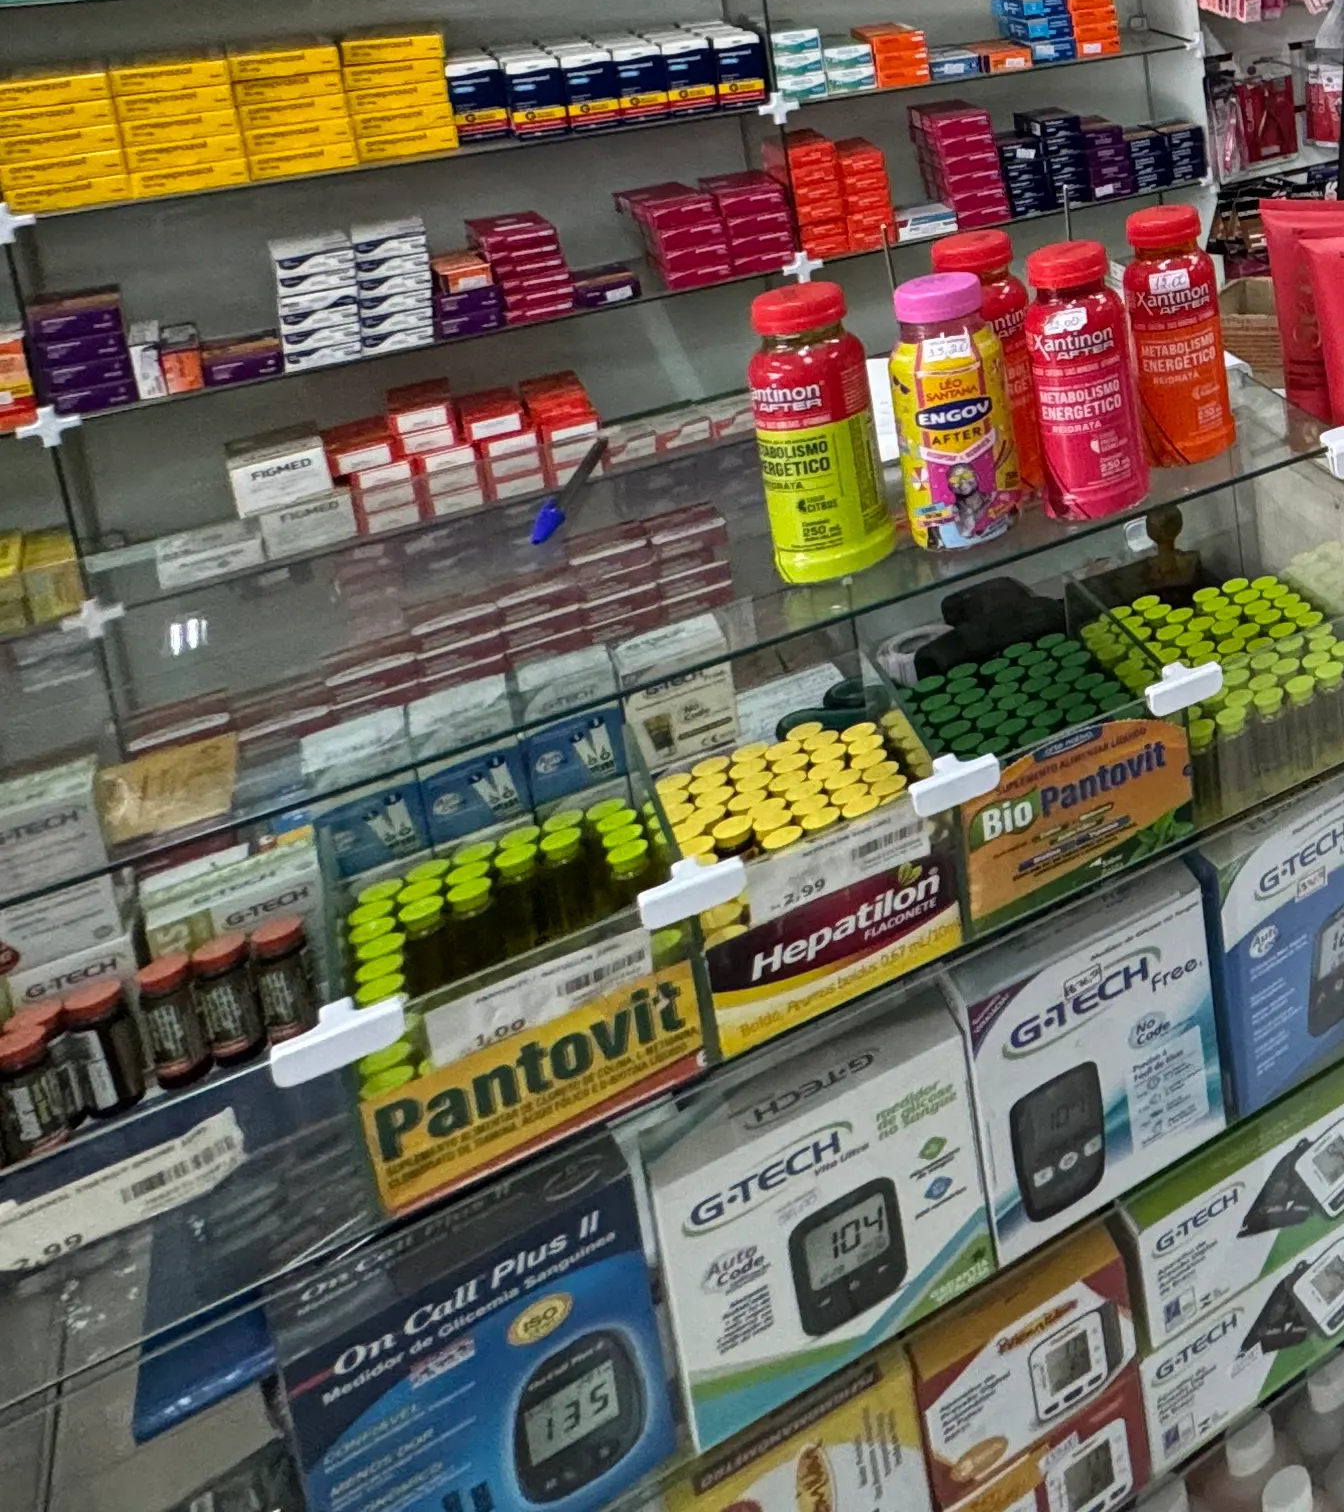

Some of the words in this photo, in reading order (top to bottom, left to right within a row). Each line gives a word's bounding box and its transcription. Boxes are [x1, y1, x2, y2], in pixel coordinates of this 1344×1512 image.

[1137, 283, 1209, 316] Xantinon
[1160, 295, 1210, 315] AFTER
[1034, 326, 1113, 361] Xantinon
[1057, 340, 1115, 361] AFTER
[1141, 333, 1214, 357] METABOLISMO
[1143, 347, 1216, 372] ENERGÉTICO
[926, 386, 978, 403] SANTANA
[939, 378, 963, 390] LÉO
[1040, 379, 1120, 404] METABOLISMO
[760, 399, 822, 413] AFTER
[918, 400, 990, 426] ENGOV
[1042, 395, 1122, 421] ENERGÉTICO
[932, 427, 982, 446] AFTER
[1052, 421, 1102, 434] REIDRATA
[251, 458, 312, 481] FIGMED
[807, 500, 838, 514] CITRUS
[803, 525, 826, 537] 250
[1040, 741, 1167, 818] Pantovit
[981, 800, 1033, 842] Bio
[784, 878, 826, 909] 2,99
[751, 871, 941, 982] Hepatilon
[864, 897, 937, 941] FLACONETE
[1151, 958, 1197, 993] Free
[476, 1018, 525, 1046] 1,00
[1136, 1019, 1156, 1035] No
[1137, 1020, 1171, 1046] Code
[374, 981, 686, 1162] Pantovit
[830, 1206, 884, 1260] 104
[707, 1245, 758, 1276] Auto
[716, 1255, 766, 1288] Code
[333, 1329, 397, 1376] On
[403, 1278, 478, 1337] Call
[490, 1232, 568, 1290] Plus
[579, 1209, 600, 1239] II
[321, 1351, 404, 1406] Medidor
[409, 1335, 434, 1356] de
[437, 1285, 521, 1337] Glicemia
[522, 1230, 617, 1289] Sanguínea
[522, 1306, 558, 1333] ISO
[545, 1382, 610, 1440] 135
